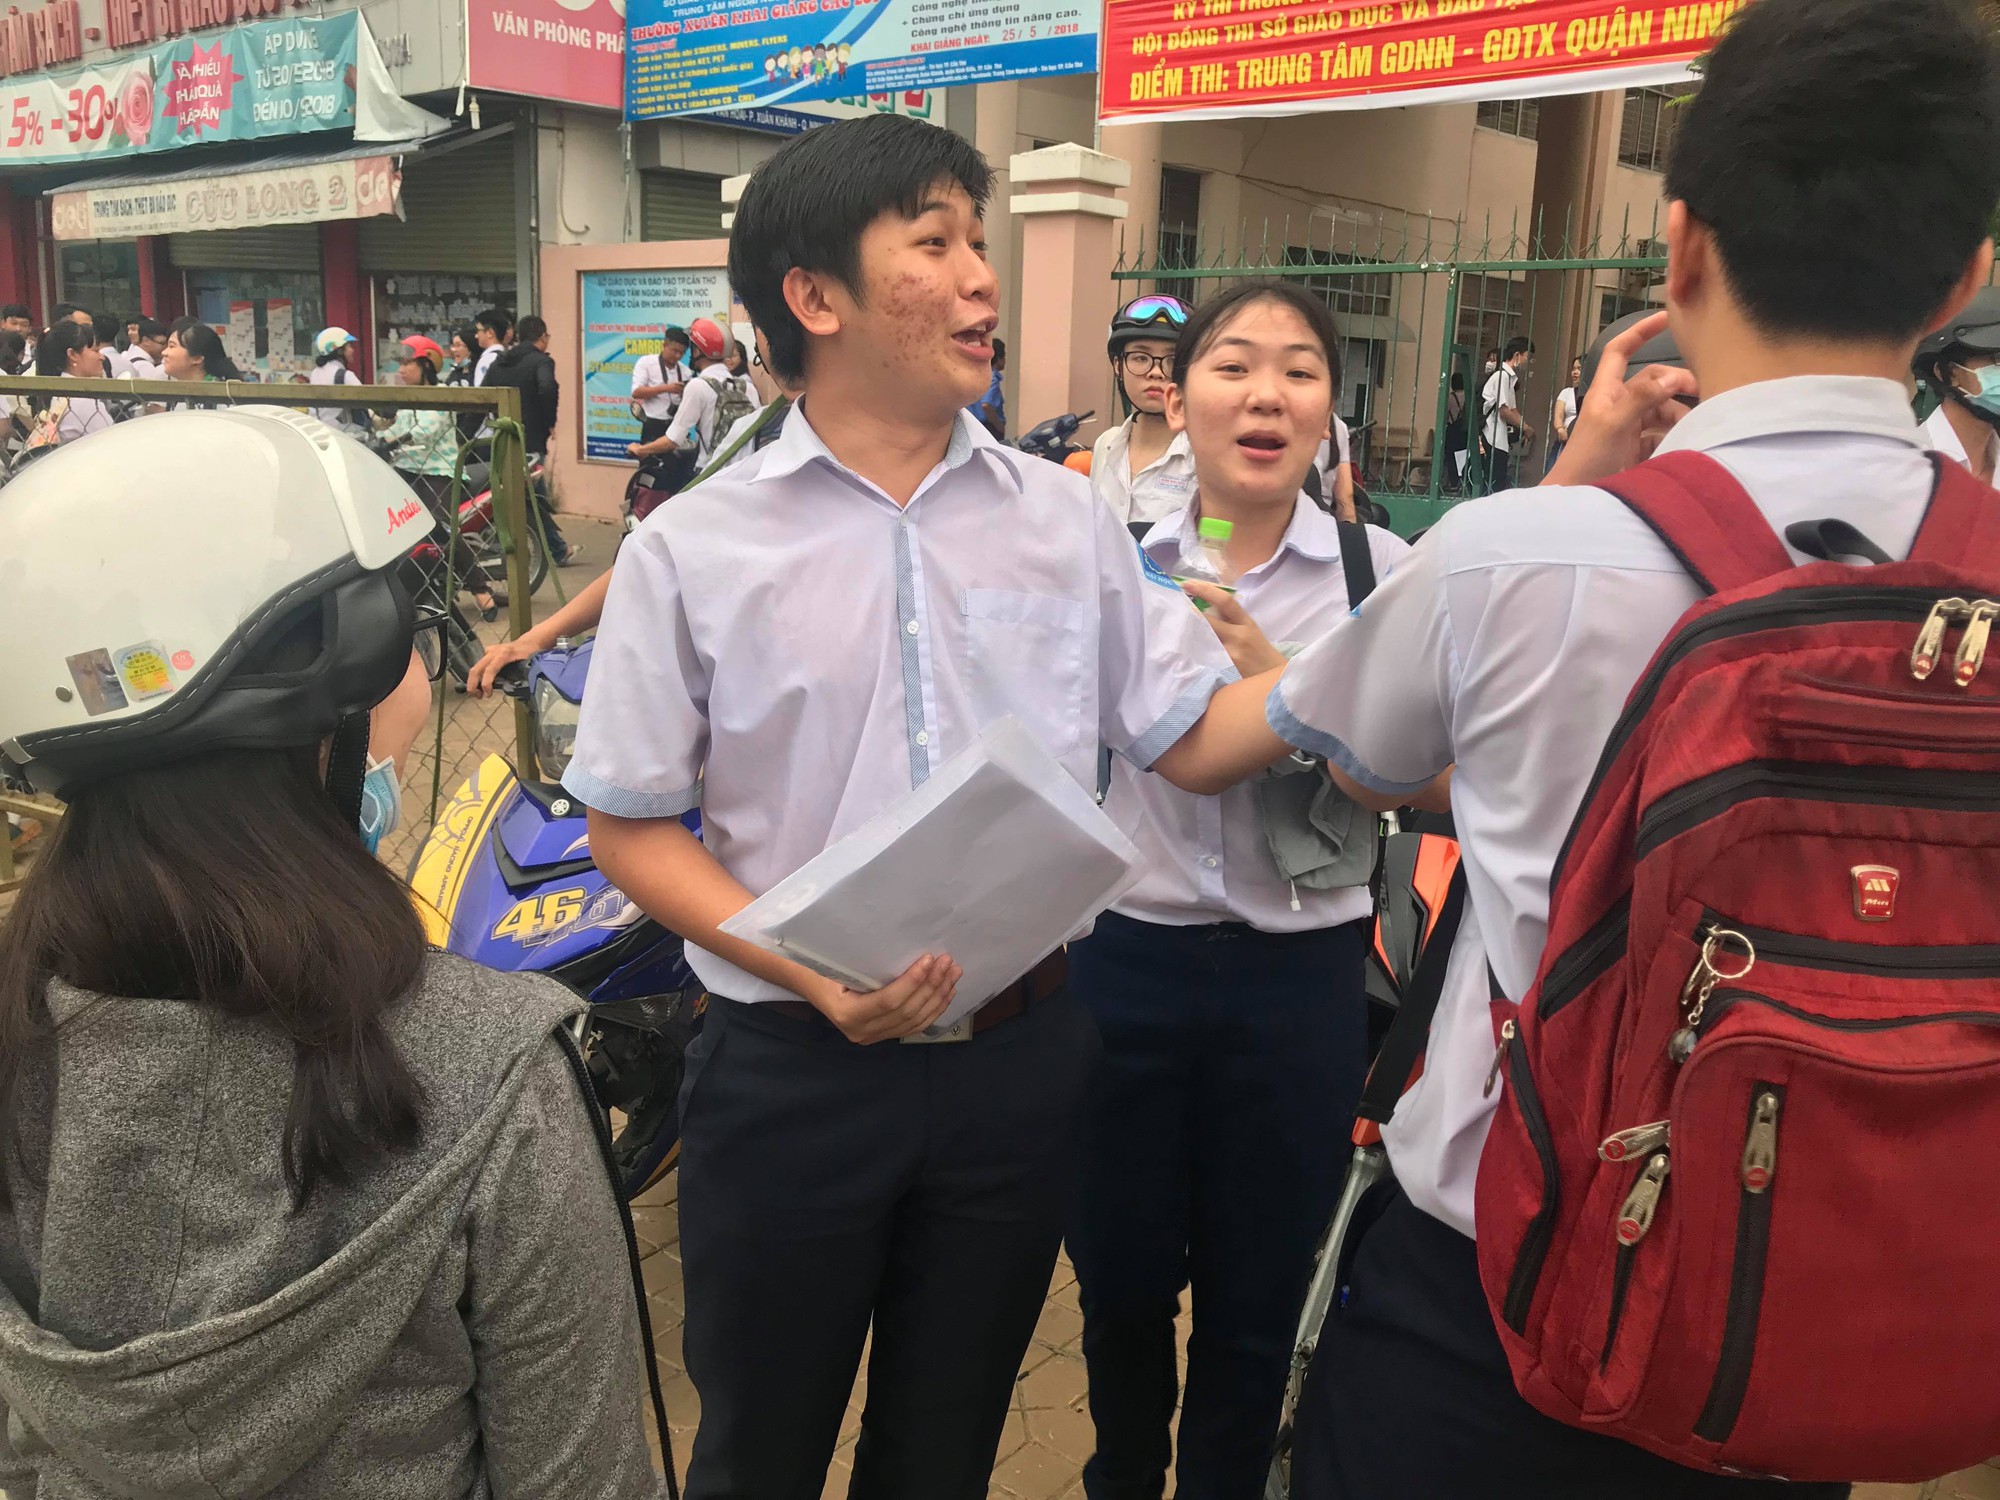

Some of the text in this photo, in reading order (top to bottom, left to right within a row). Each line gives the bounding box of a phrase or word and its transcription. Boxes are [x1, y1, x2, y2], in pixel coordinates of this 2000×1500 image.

[672, 5, 704, 18] TRUNG
[706, 1, 726, 12] TÂM
[683, 13, 729, 33] XUYÊN
[730, 8, 768, 25] KHAI
[911, 2, 939, 13] Công
[1204, 0, 1233, 16] THI
[492, 10, 530, 38] VĂN
[533, 18, 592, 49] PHÒNG
[911, 28, 938, 39] Công
[940, 23, 968, 35] nghệ
[970, 18, 1002, 30] thông
[1004, 14, 1021, 25] tin
[1055, 8, 1083, 19] cao.
[1132, 33, 1162, 57] HỘI
[1167, 24, 1219, 51] ĐỒNG
[1224, 23, 1254, 43] THI
[1260, 12, 1287, 39] SỞ
[1294, 9, 1343, 35] GIÁO
[1348, 4, 1393, 30] DỤC
[910, 43, 932, 54] KHAI
[964, 33, 991, 47] NGÀY:
[1130, 57, 1182, 101] ĐIỂM
[1190, 62, 1229, 95] THI:
[1236, 52, 1313, 91] TRUNG
[1320, 41, 1374, 81] TÂM
[1380, 34, 1456, 75] GDNN
[1462, 46, 1475, 56] -
[1482, 22, 1558, 64] GDTX
[1566, 8, 1654, 57] QUẬN
[245, 179, 321, 220] LONG
[328, 174, 349, 211] 2
[652, 299, 691, 309] CAMBRIDGE
[682, 288, 693, 296] TIN
[387, 498, 422, 535] Andes
[491, 886, 587, 942] 46
